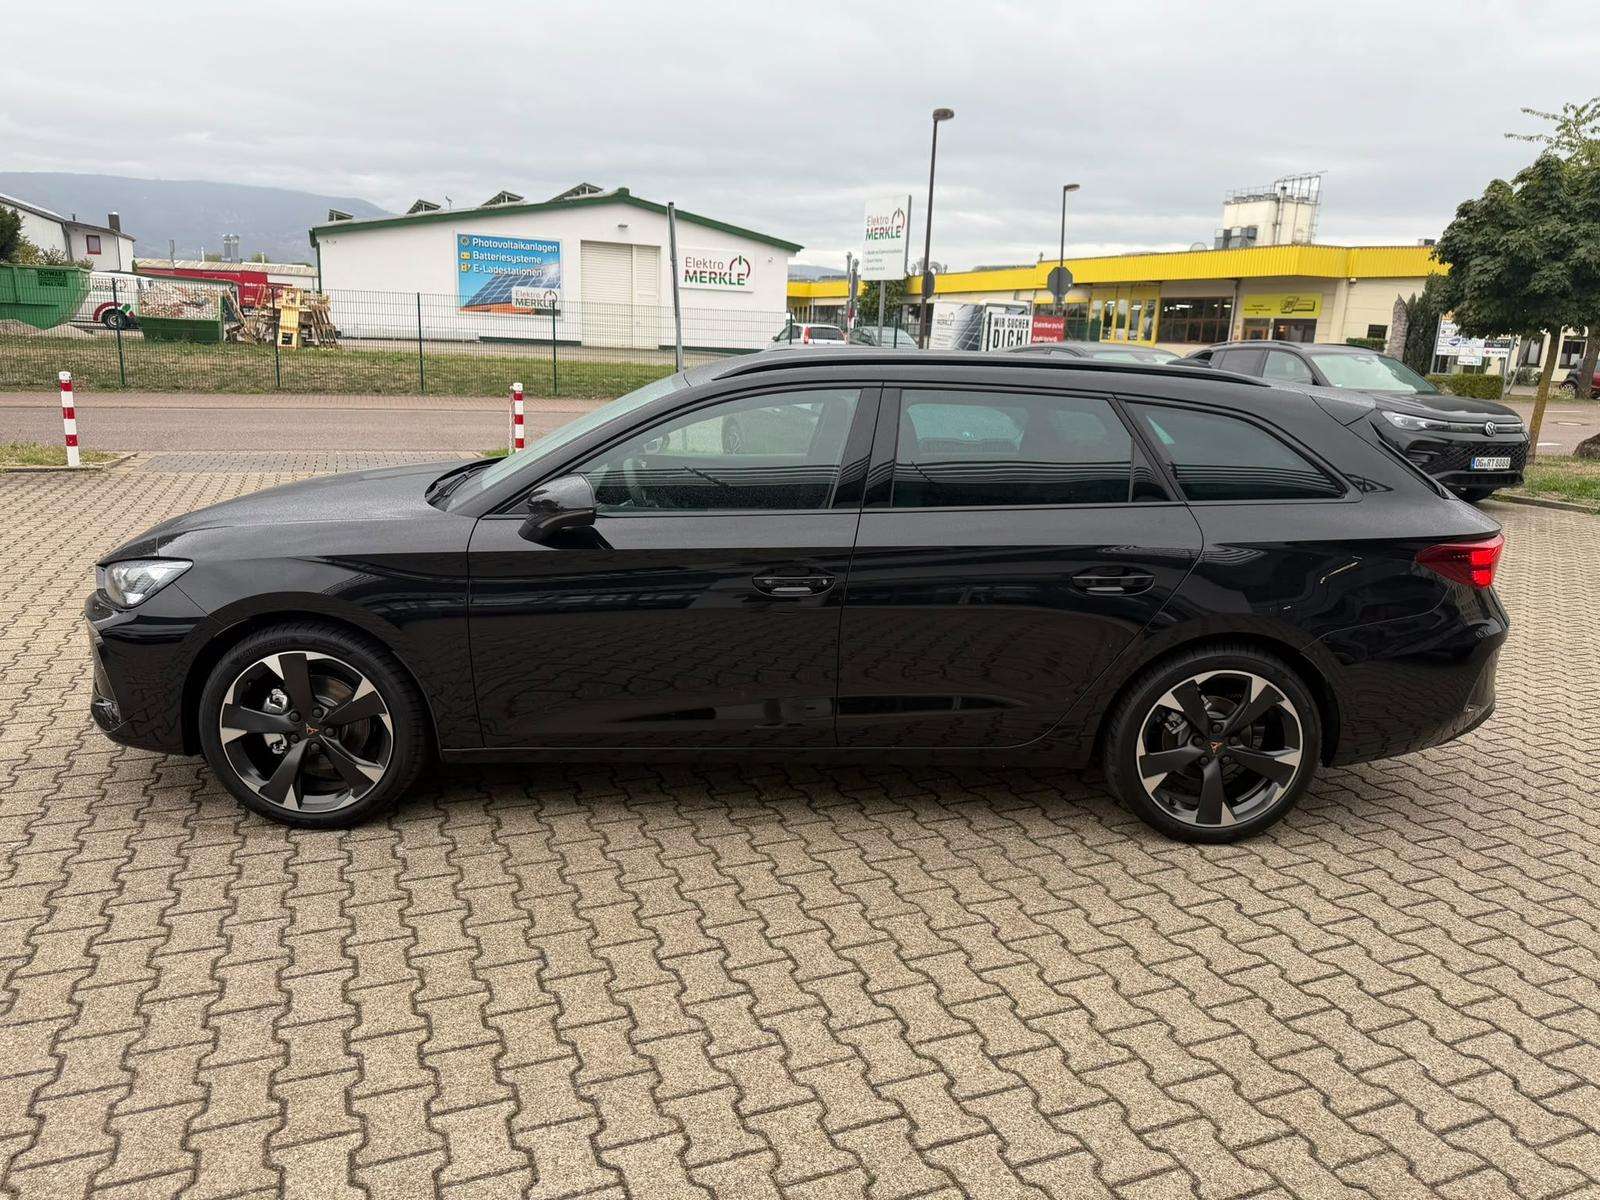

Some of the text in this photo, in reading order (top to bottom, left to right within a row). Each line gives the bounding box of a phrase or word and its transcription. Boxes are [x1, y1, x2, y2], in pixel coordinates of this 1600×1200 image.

[866, 216, 890, 226] Elektro
[865, 225, 902, 241] MERKLE
[472, 237, 558, 254] Photovoltaikanlagen
[473, 250, 542, 265] Batteriesysteme
[685, 256, 724, 270] Elektro
[473, 264, 543, 277] E-Ladestationen
[684, 269, 746, 286] MERKLE
[515, 290, 542, 299] Elektro
[515, 298, 556, 309] MERKLE
[993, 317, 1005, 328] WIR
[1007, 317, 1029, 329] SUCHEN
[992, 329, 1029, 349] DICH!
